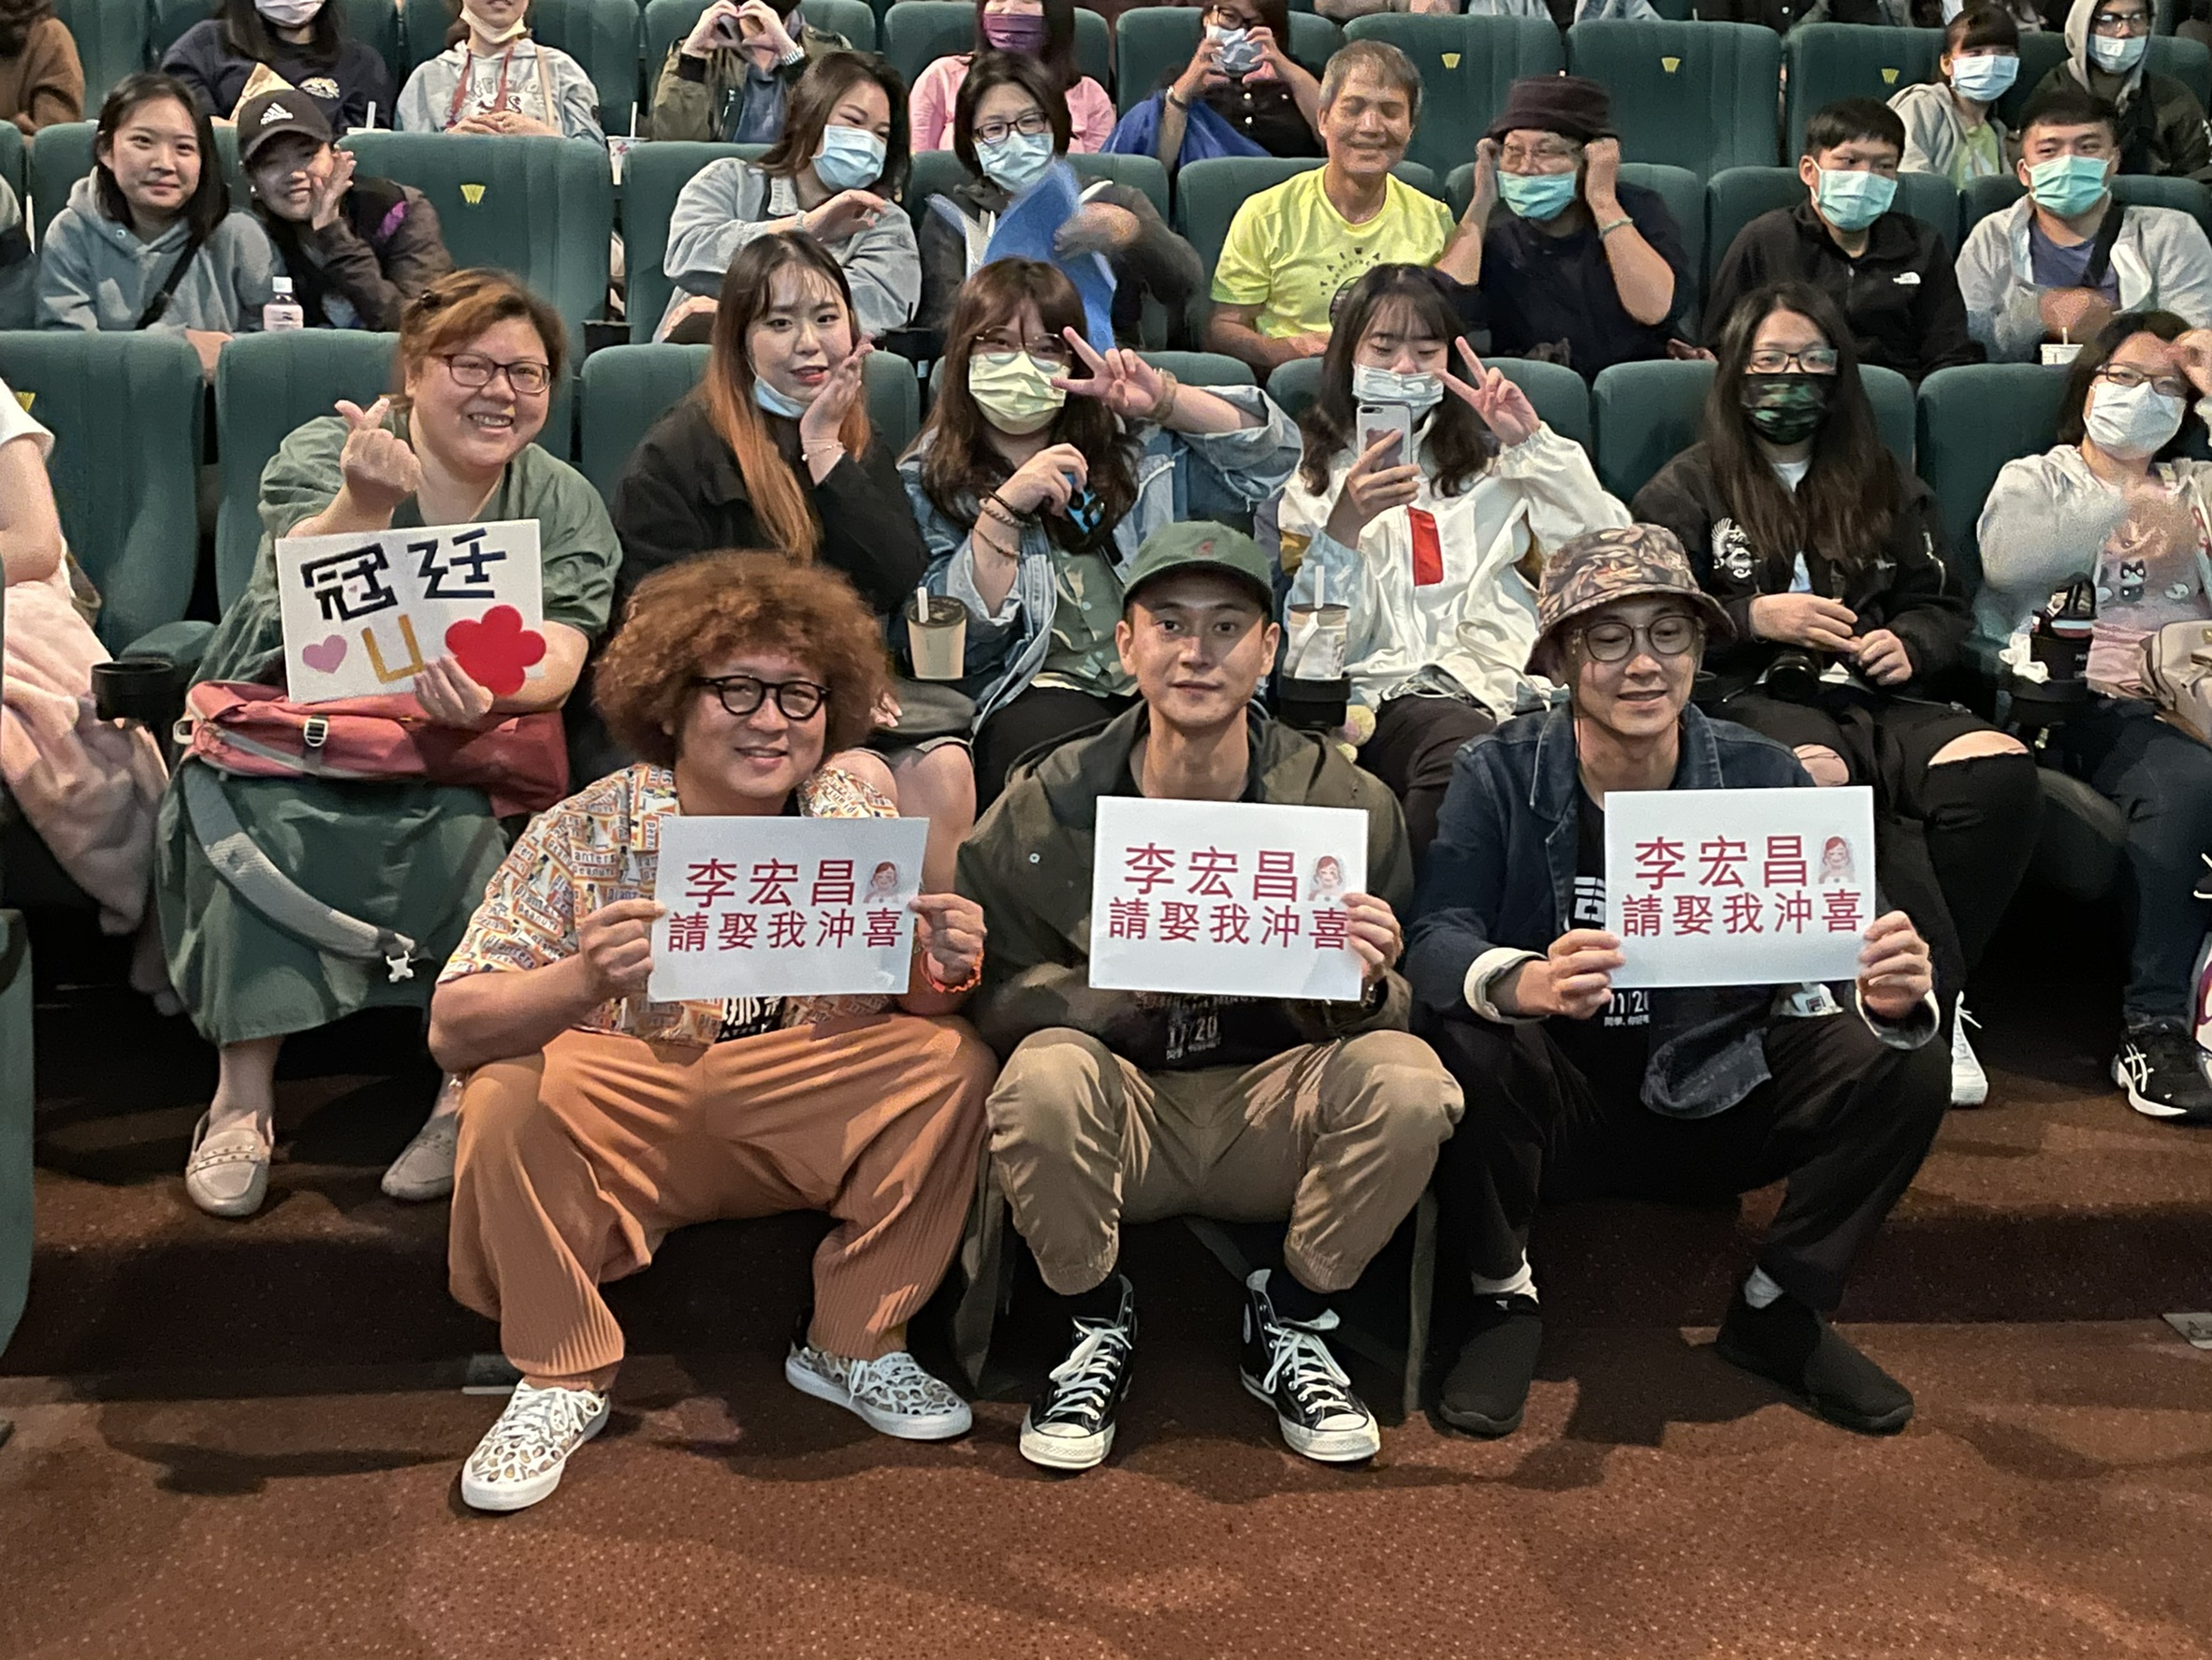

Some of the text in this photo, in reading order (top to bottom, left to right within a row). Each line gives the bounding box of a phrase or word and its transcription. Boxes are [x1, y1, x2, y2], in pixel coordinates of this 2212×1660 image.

[574, 851, 616, 863] anters
[1124, 842, 1298, 902] 李宏昌
[1635, 835, 1808, 890] 李宏昌
[685, 858, 855, 909] 李宏昌
[668, 908, 903, 952] 請娶我沖喜
[1109, 896, 1349, 951] 請娶我沖喜
[1622, 889, 1863, 937] 請娶我沖喜
